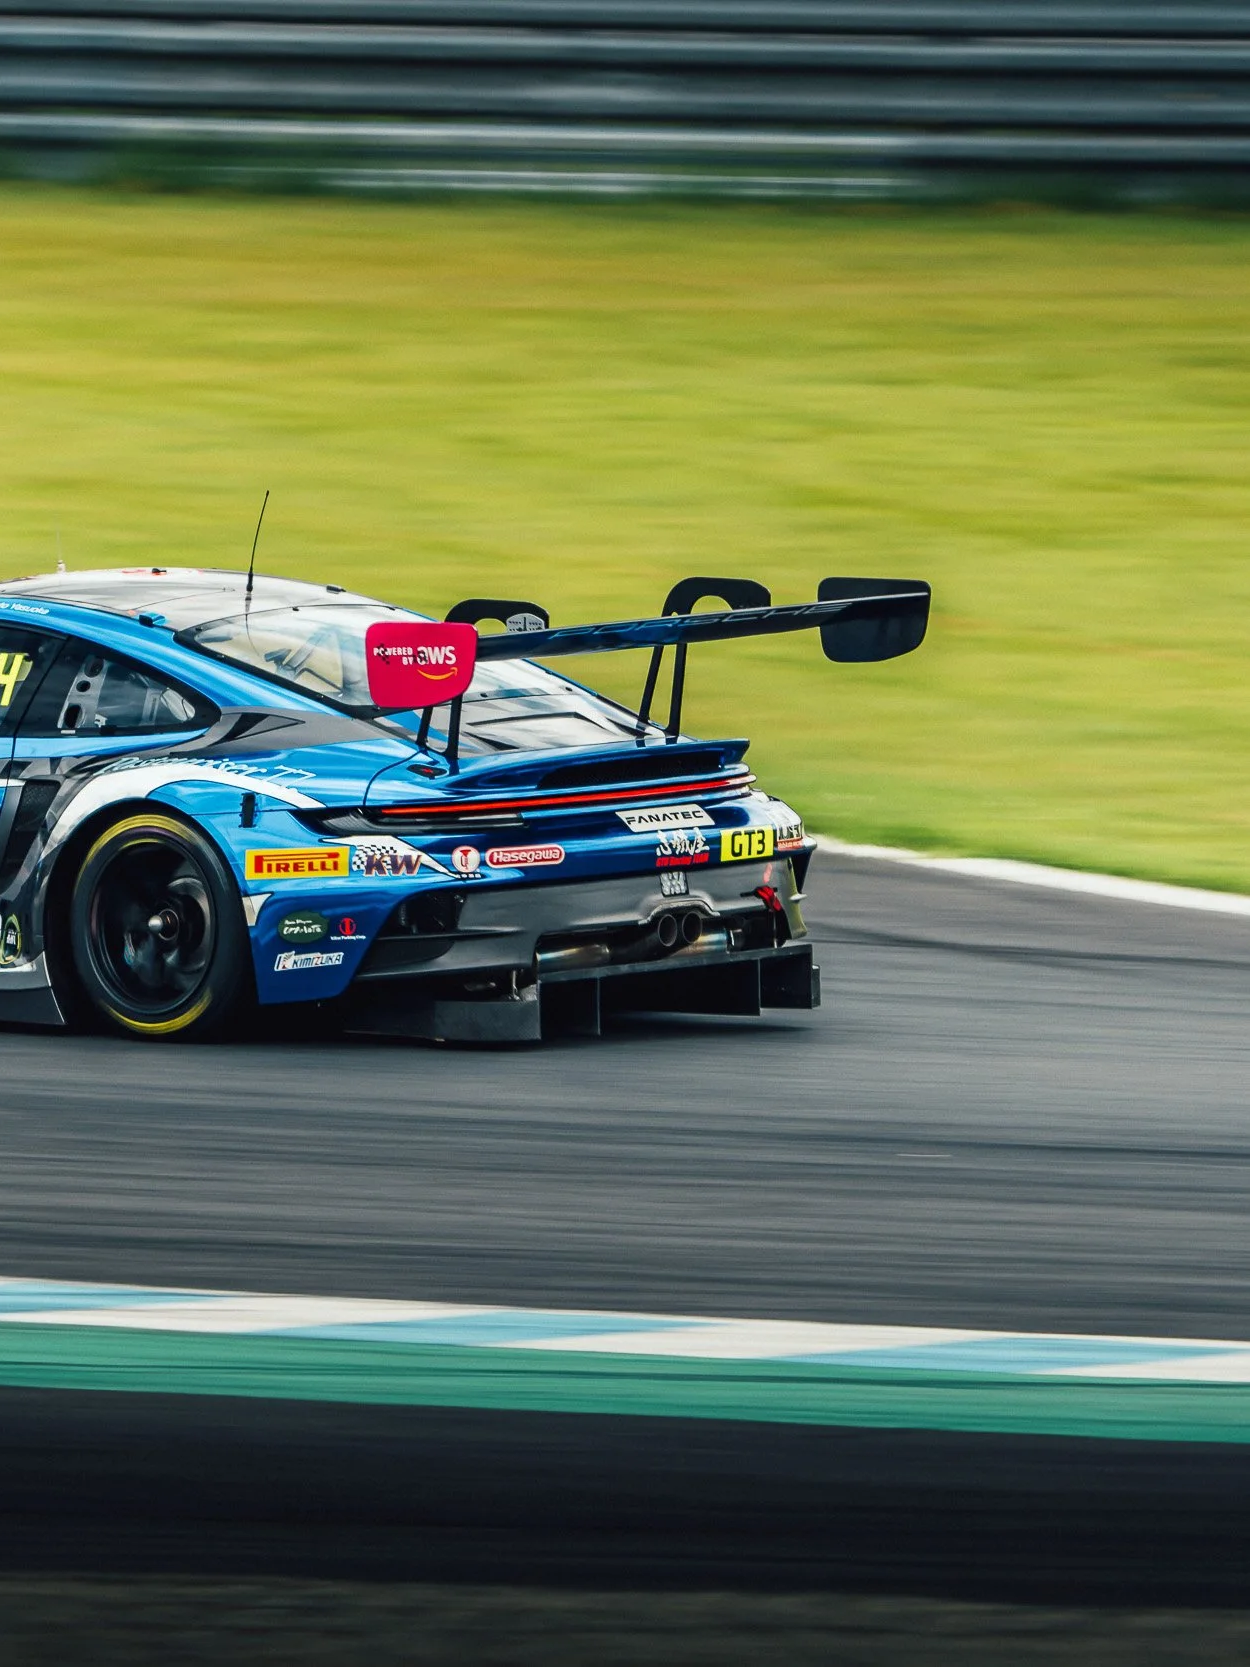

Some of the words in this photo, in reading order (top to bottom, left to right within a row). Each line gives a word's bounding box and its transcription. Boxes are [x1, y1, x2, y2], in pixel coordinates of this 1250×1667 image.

[549, 602, 852, 639] PORSCHE
[373, 647, 413, 656] POWERED
[402, 656, 414, 666] BY
[625, 810, 705, 825] FANATEC
[730, 829, 766, 858] GT3
[254, 852, 340, 873] PIRELLI
[493, 848, 561, 864] Hasegawa
[364, 854, 423, 877] KW
[292, 954, 342, 968] KIMIZUKA
